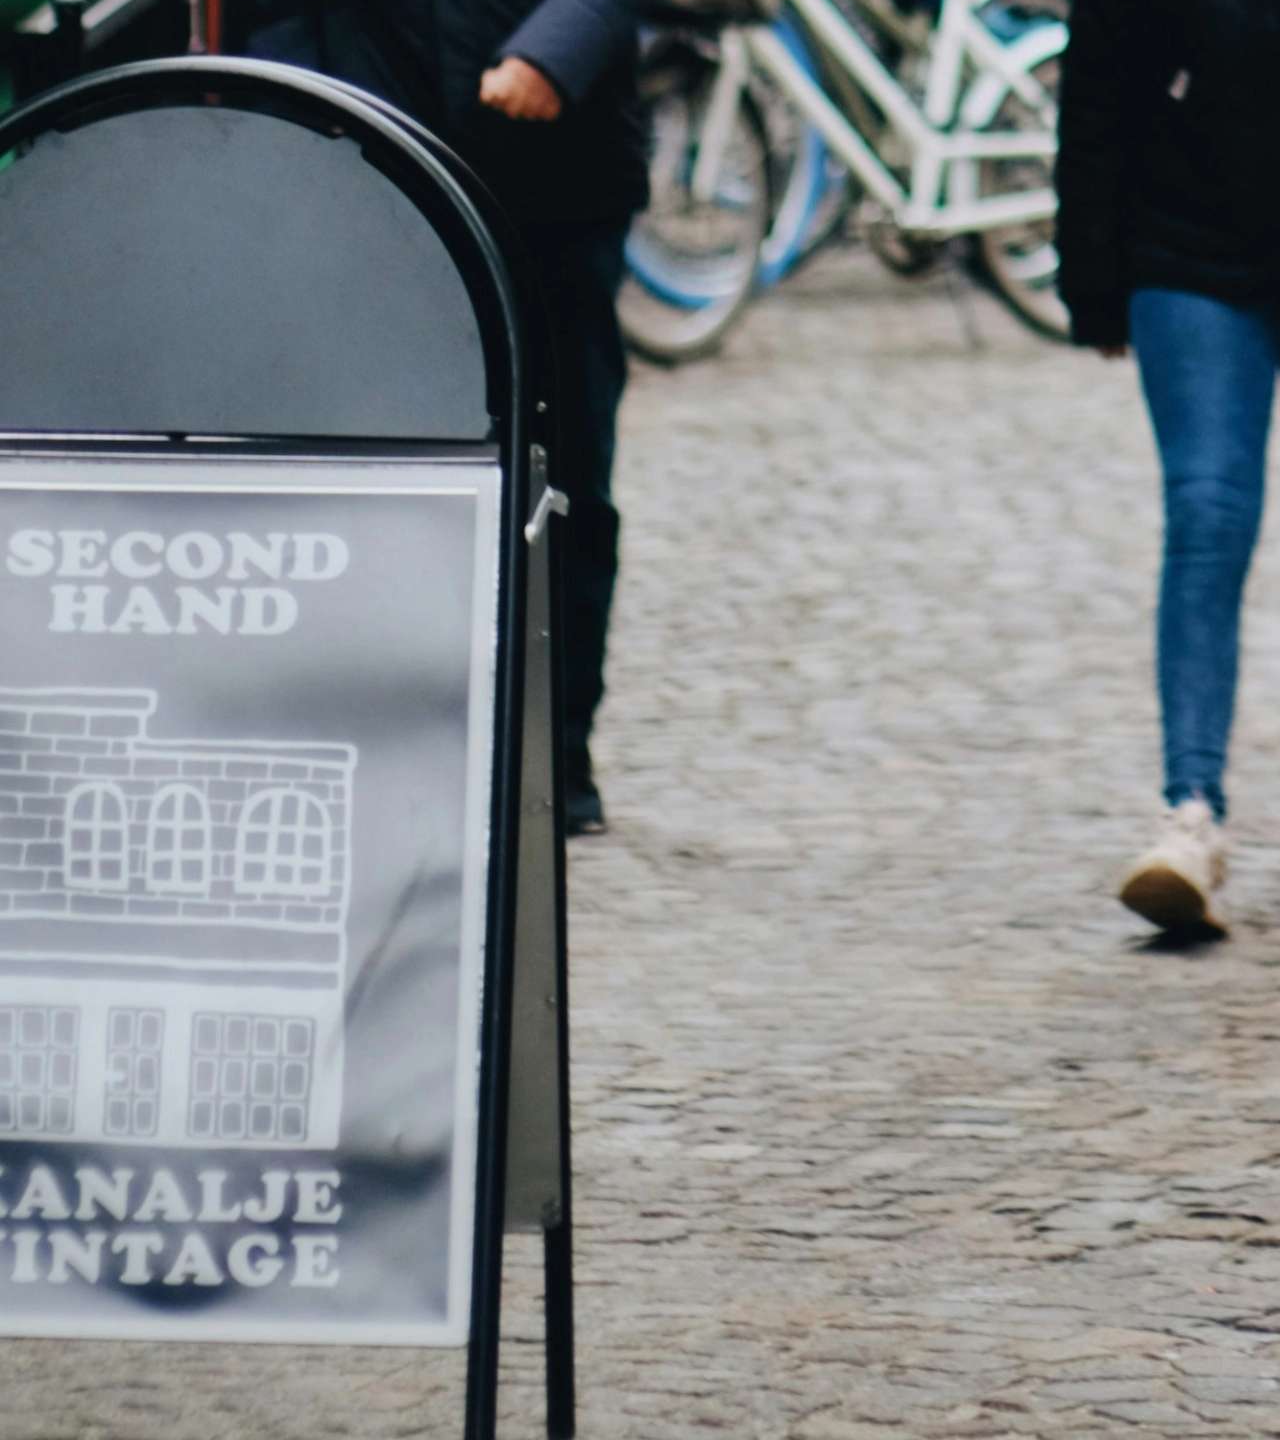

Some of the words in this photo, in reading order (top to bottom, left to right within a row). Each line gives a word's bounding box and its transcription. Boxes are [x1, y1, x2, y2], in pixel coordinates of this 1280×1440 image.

[6, 529, 350, 580] SECOND
[48, 584, 299, 635] HAND
[0, 1165, 343, 1224] ANALJE
[0, 1229, 340, 1287] INTAGE
